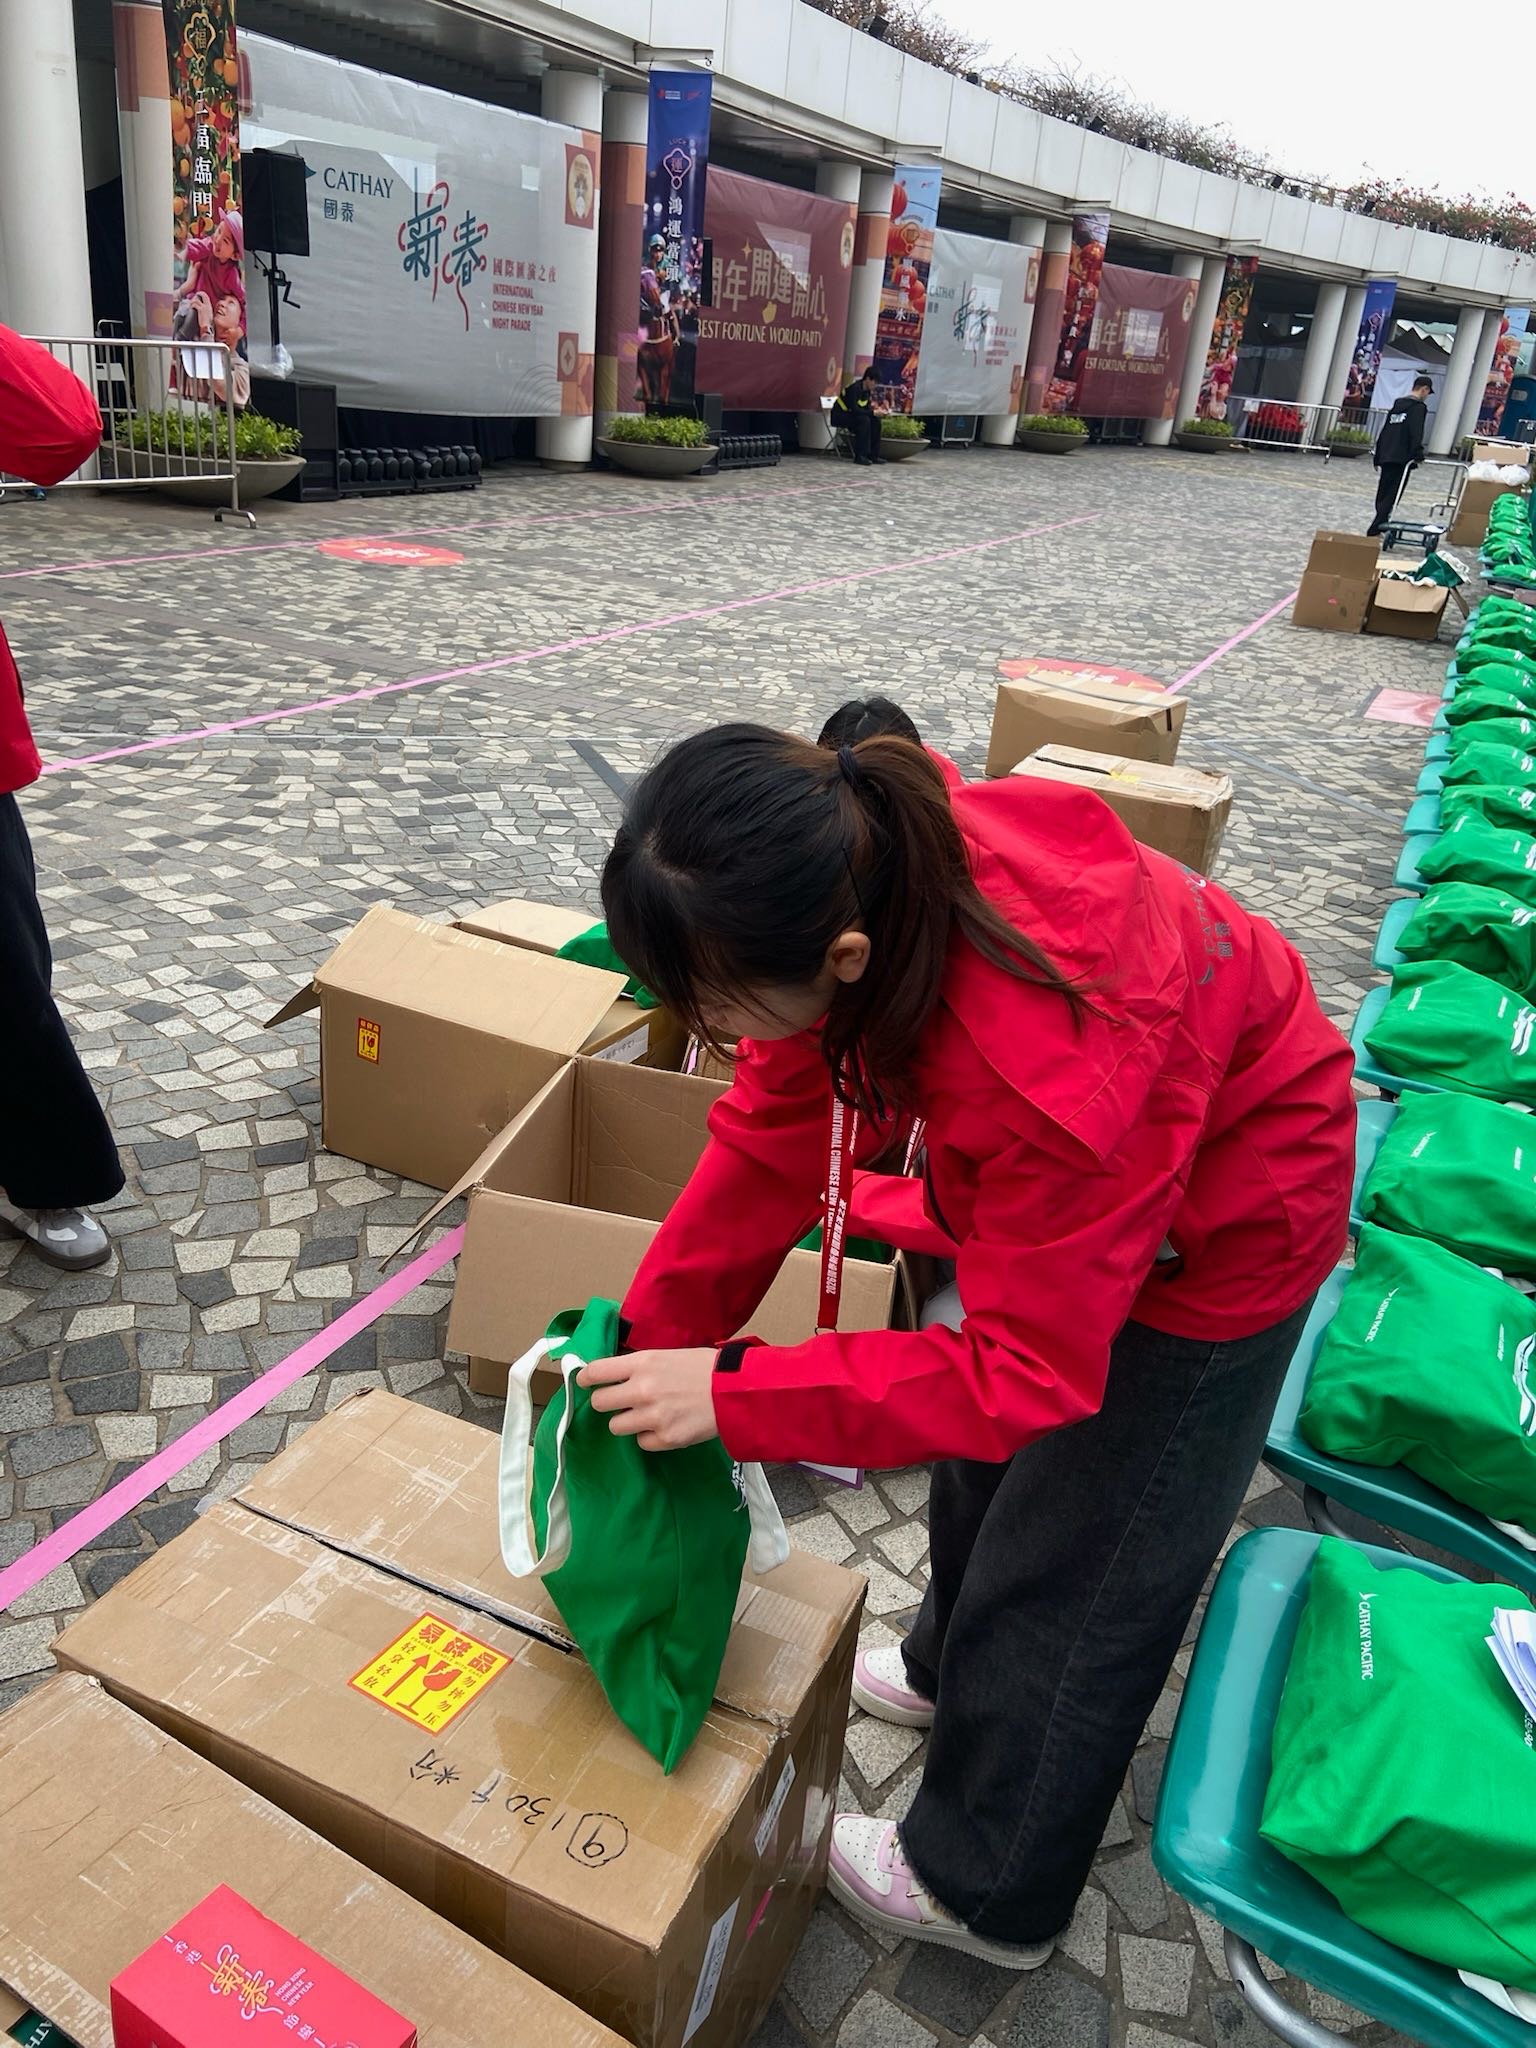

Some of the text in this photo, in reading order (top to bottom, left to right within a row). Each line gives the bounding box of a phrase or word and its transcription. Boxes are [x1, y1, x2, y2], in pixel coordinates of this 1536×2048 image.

[324, 167, 394, 199] CATHAY
[324, 198, 354, 222] 國泰
[398, 167, 488, 305] 新春
[666, 196, 683, 284] 鴻運當頭
[493, 283, 534, 299] INTERNATIONAL
[493, 300, 543, 316] CHINESE NEW YEAR
[492, 317, 531, 331] NIGHT PARADE
[722, 321, 766, 343] FORTUNE
[769, 326, 801, 346] WORLD
[800, 329, 822, 348] PARTY
[829, 1149, 842, 1187] CHINESE
[419, 1623, 498, 1674] 易碎品
[1359, 1601, 1374, 1680] CATHAY PACIFIC
[173, 1940, 203, 1965] 香港
[274, 1967, 308, 1997] HONG KONG
[280, 1978, 306, 2002] CHINESE
[286, 1980, 316, 2007] NEW YEAR
